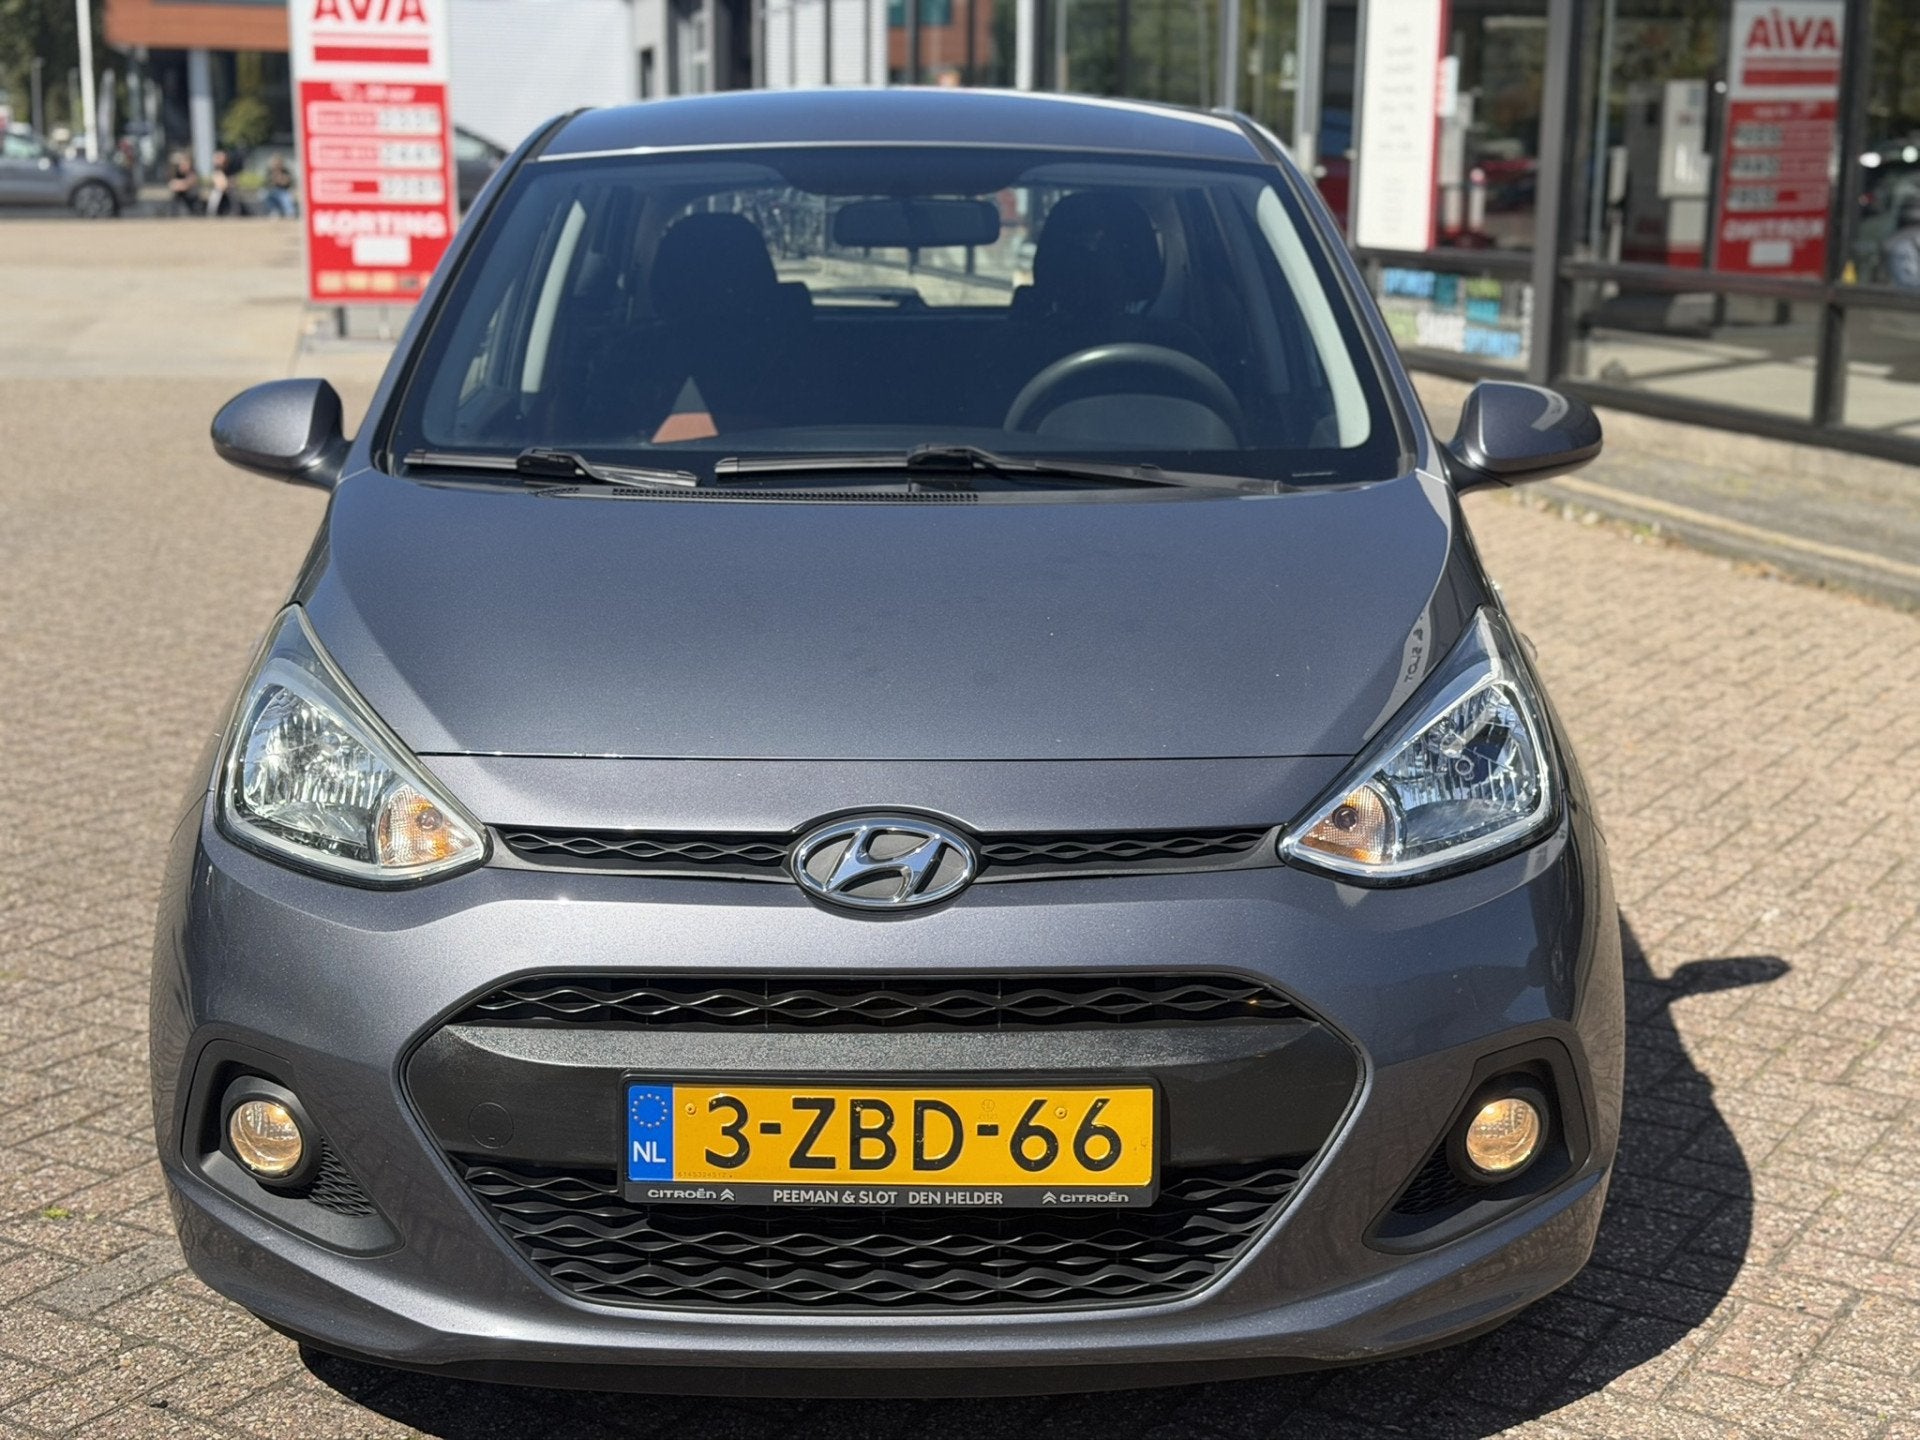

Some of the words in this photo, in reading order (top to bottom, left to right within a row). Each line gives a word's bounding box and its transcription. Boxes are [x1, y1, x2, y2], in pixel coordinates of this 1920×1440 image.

[704, 1095, 1122, 1172] 3-ZBD-66
[633, 1141, 667, 1164] NL
[773, 1189, 838, 1203] PEEMAN
[842, 1190, 856, 1204] &
[858, 1190, 898, 1204] SLOT
[908, 1191, 941, 1204] DEN
[945, 1191, 1004, 1205] HELDER
